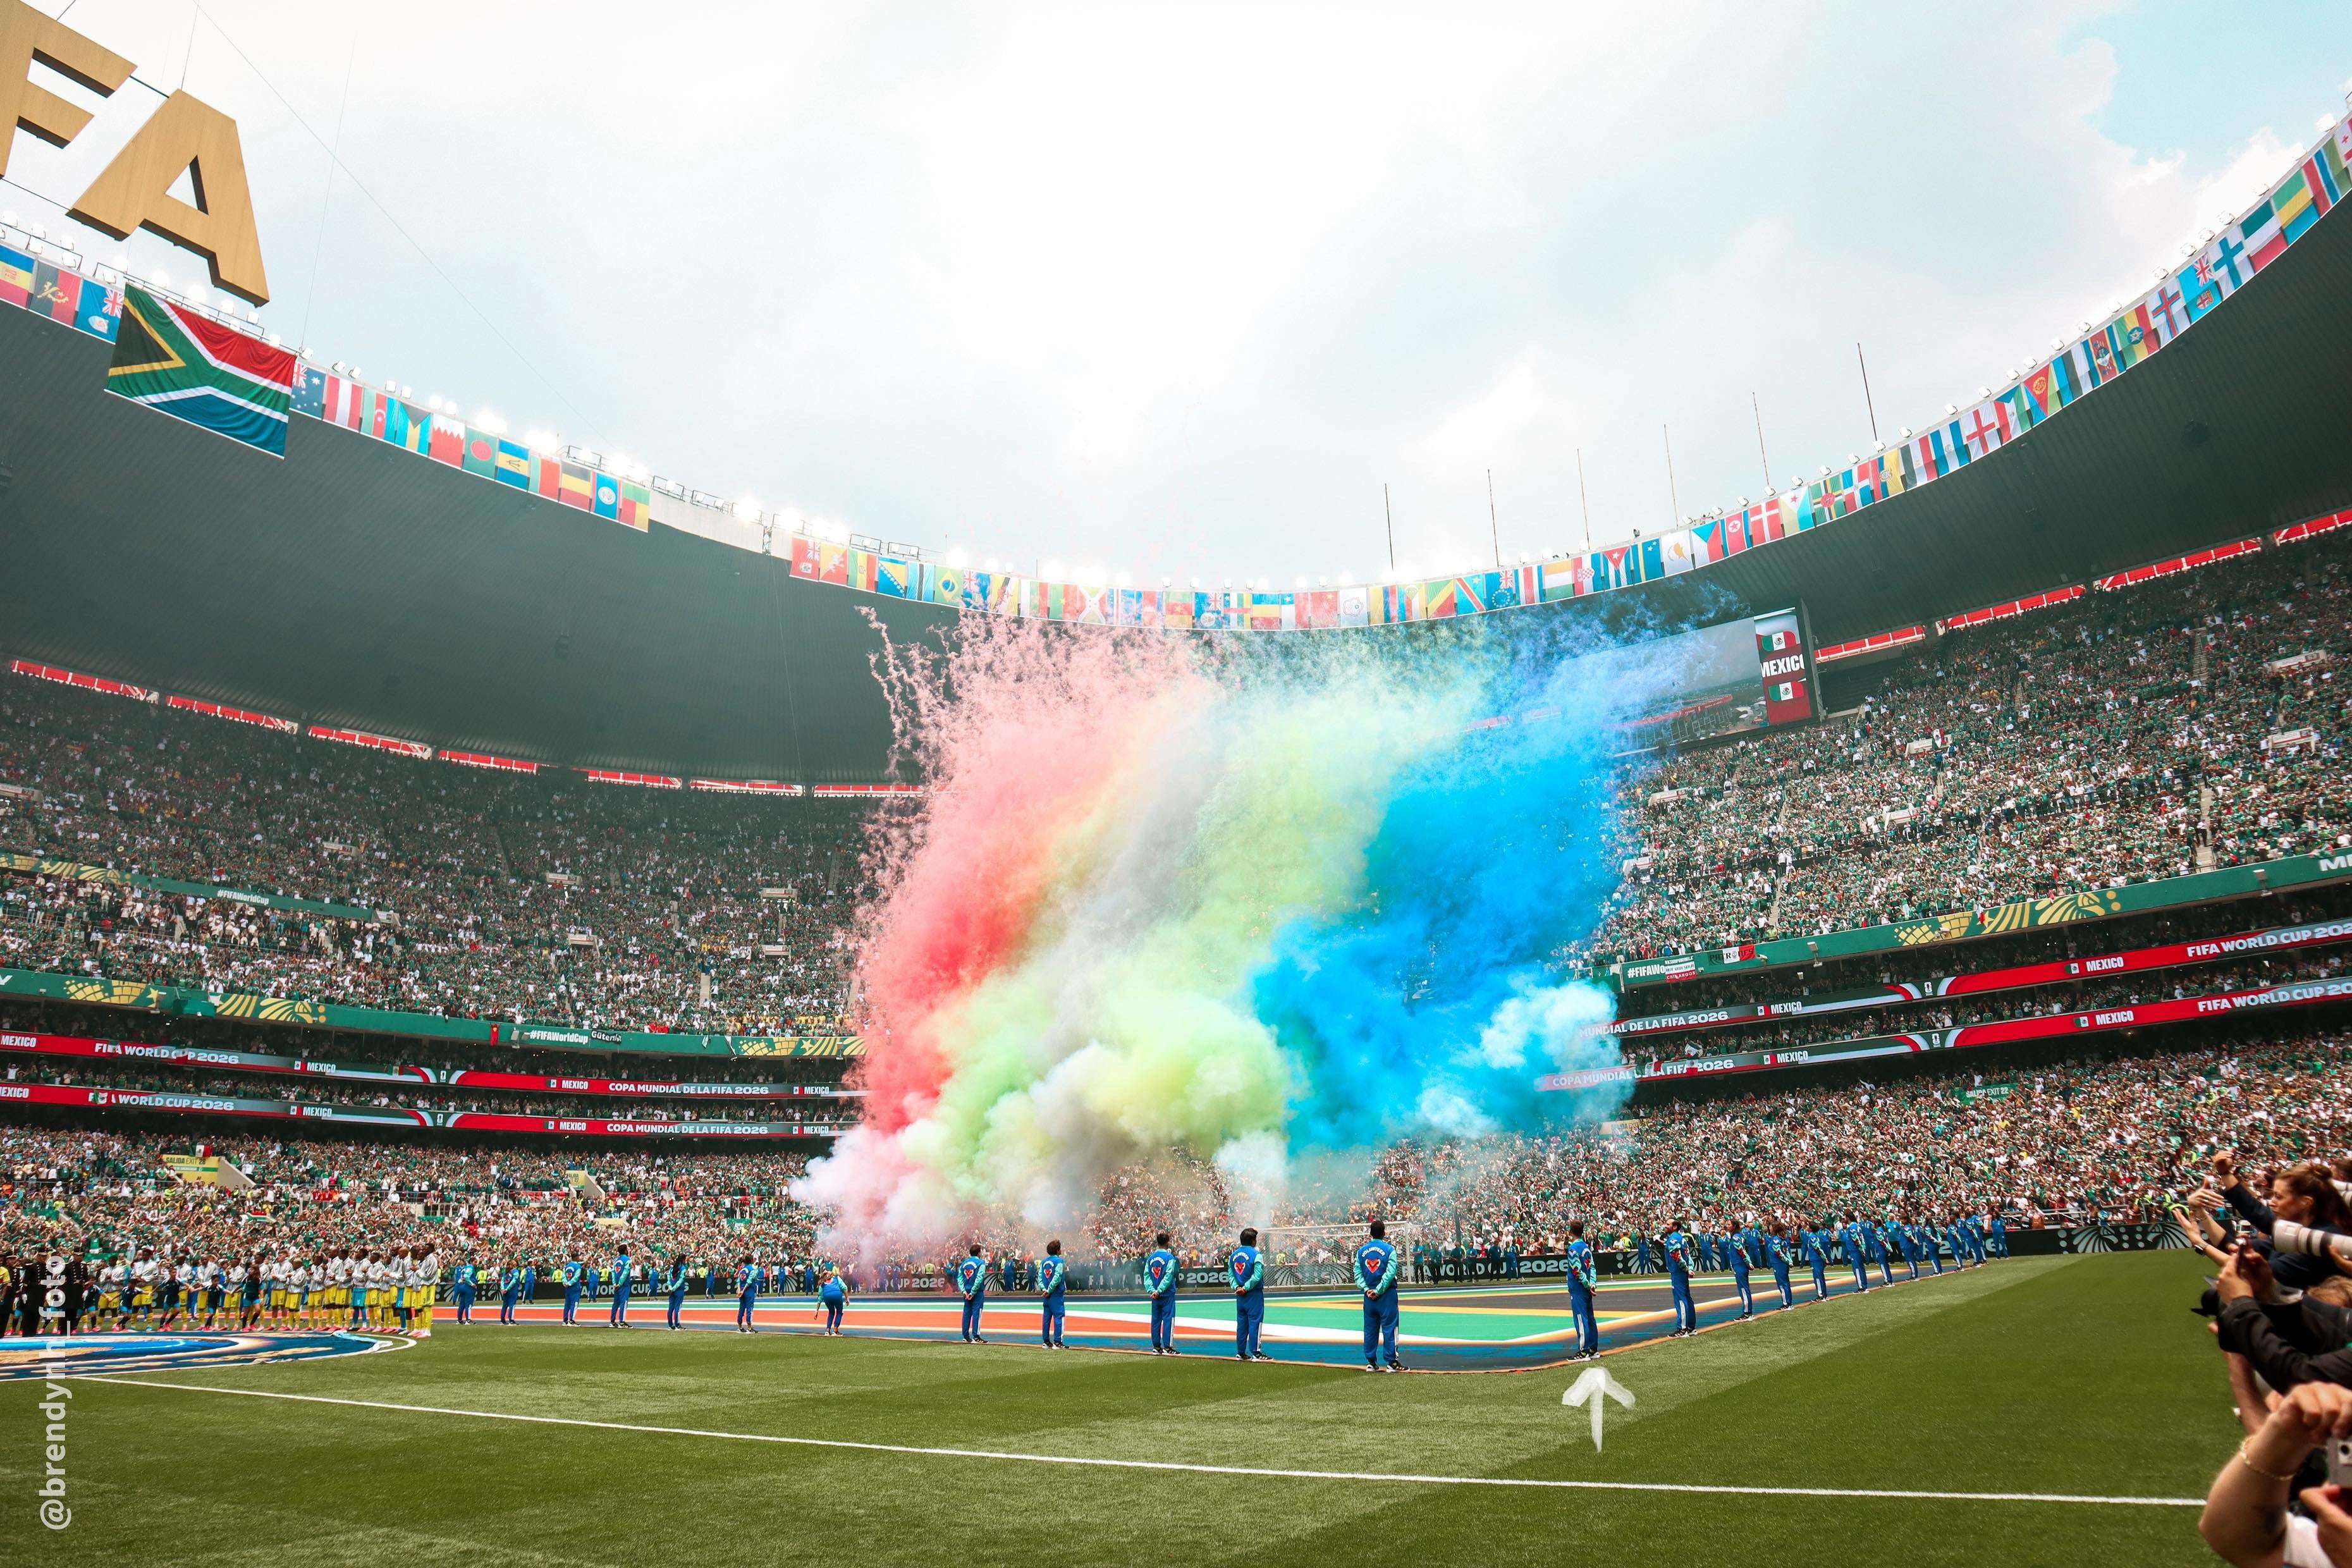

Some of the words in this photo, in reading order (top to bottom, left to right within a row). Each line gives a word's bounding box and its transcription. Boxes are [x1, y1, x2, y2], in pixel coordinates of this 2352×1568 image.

[217, 889, 269, 905] #FIFAWorldCup
[2186, 944, 2221, 957] FIFA
[2220, 934, 2277, 952] WORLD
[2280, 929, 2313, 943] CUP
[1627, 964, 1665, 979] #FIFAWo
[2086, 957, 2124, 972] MEXICO
[2197, 998, 2233, 1012] FIFA
[2232, 991, 2291, 1008] WORLD
[2292, 986, 2325, 1000] CUP
[1580, 1023, 1628, 1038] MUNDIAL
[1629, 1022, 1644, 1032] DE
[1645, 1020, 1660, 1030] LA
[1662, 1017, 1686, 1027] FIFA
[1688, 1011, 1728, 1024] 2026
[1770, 1001, 1802, 1015] MEXICO
[2095, 1010, 2135, 1026] MEXICO
[1, 1035, 37, 1048] MEXICO
[530, 1030, 589, 1044] #FIFAWorldCup
[95, 1043, 122, 1055] FIA
[125, 1046, 168, 1058] WORLD
[171, 1050, 196, 1062] CP
[197, 1053, 240, 1065] 2026
[307, 1062, 336, 1073] MEXICO
[1777, 1051, 1809, 1063] MEXICO
[1667, 1064, 1687, 1075] FIFA
[1696, 1059, 1734, 1072] 2026
[1552, 1077, 1582, 1086] COPA
[1583, 1072, 1632, 1084] MUNDIAL
[562, 1080, 589, 1090] MEXICO
[609, 1083, 636, 1093] COPA
[637, 1084, 682, 1094] MUNDIAL
[683, 1086, 696, 1094] DE
[697, 1086, 711, 1094] LA
[711, 1086, 733, 1094] FIFA
[734, 1086, 769, 1094] 2026
[804, 1086, 830, 1094] MEXICO
[1987, 1087, 2000, 1096] EXIT
[118, 1094, 164, 1107] WORLD
[166, 1097, 191, 1108] CUP
[192, 1100, 235, 1112] 2026
[302, 1106, 333, 1117] MEXICO
[560, 1122, 587, 1131] MEXICO
[607, 1124, 634, 1133] COPA
[635, 1124, 680, 1134] MUNDIAL
[682, 1125, 695, 1134] DE
[695, 1125, 709, 1134] LA
[711, 1125, 732, 1134] FIFA
[733, 1125, 768, 1134] 2026
[803, 1125, 829, 1134] MEXICO
[1361, 1246, 1386, 1258] VOLUNTEER
[1440, 1263, 1485, 1276] WORD
[1519, 1260, 1569, 1273] 2026
[912, 1278, 945, 1288] 2026
[1186, 1271, 1229, 1283] 2026
[656, 1282, 690, 1293] 206
